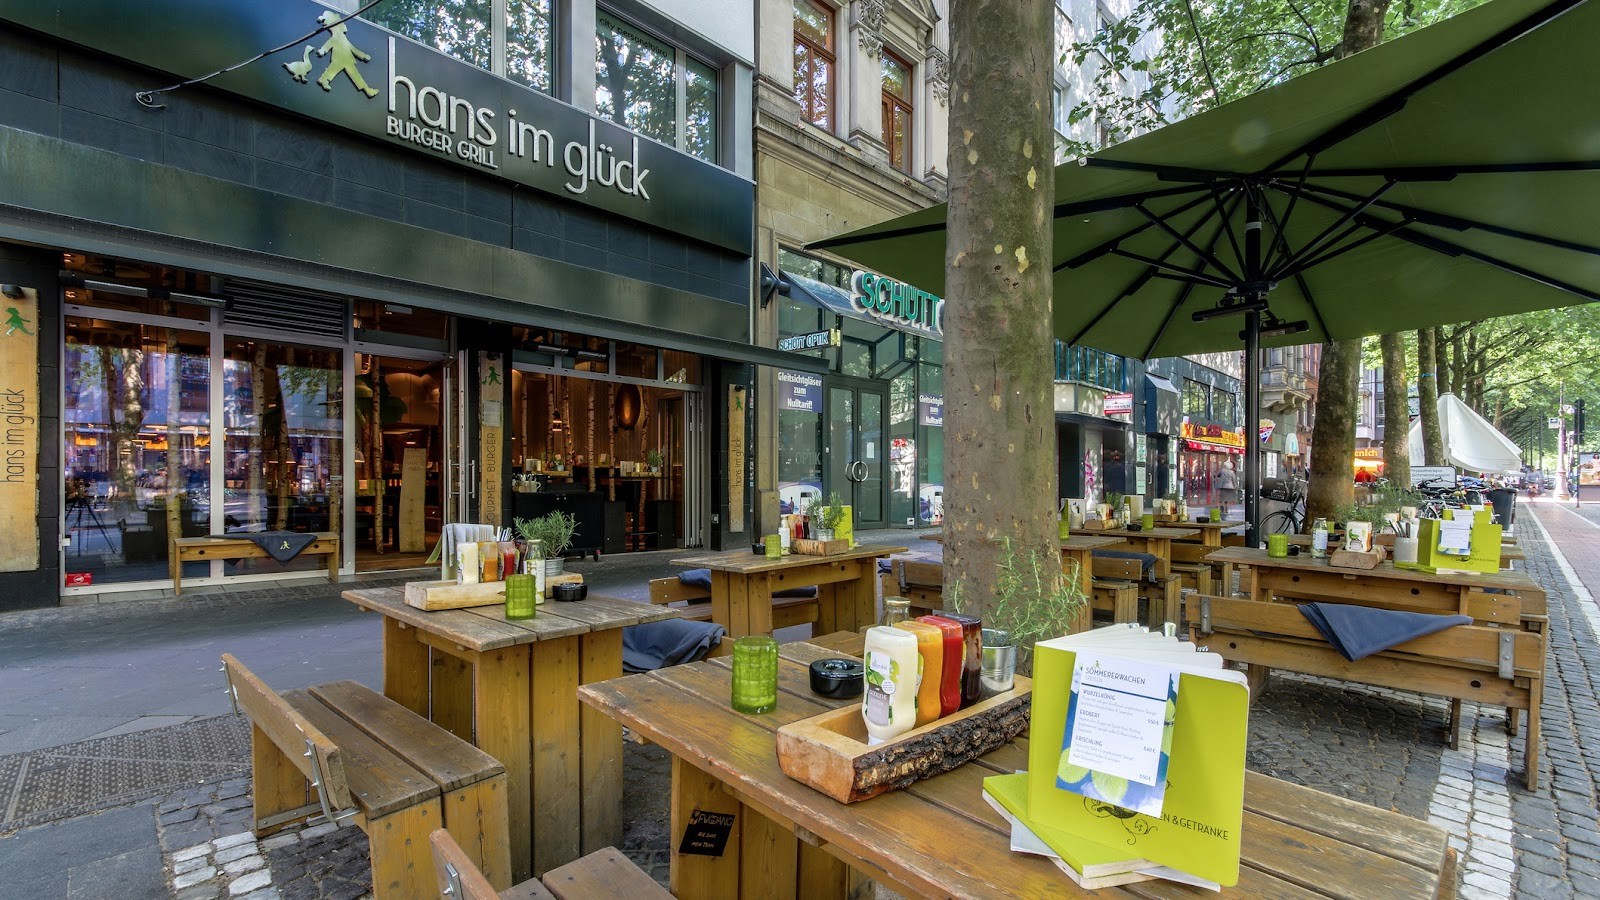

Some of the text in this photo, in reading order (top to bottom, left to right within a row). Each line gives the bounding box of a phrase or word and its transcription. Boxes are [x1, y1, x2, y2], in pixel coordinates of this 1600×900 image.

[388, 36, 650, 200] hans im glück
[386, 115, 499, 169] BURGER GRILL
[806, 331, 829, 347] OPTIK
[778, 371, 822, 387] Gleitsichtgläser
[794, 387, 806, 395] zum
[787, 398, 812, 409] Nulltarif!
[0, 388, 34, 482] hans im glück
[487, 432, 496, 472] BURGER
[1355, 448, 1378, 457] enich
[1085, 667, 1146, 685] SOMMERERWACHEN
[1172, 815, 1178, 826] &
[1180, 817, 1229, 841] GETRÄNKE
